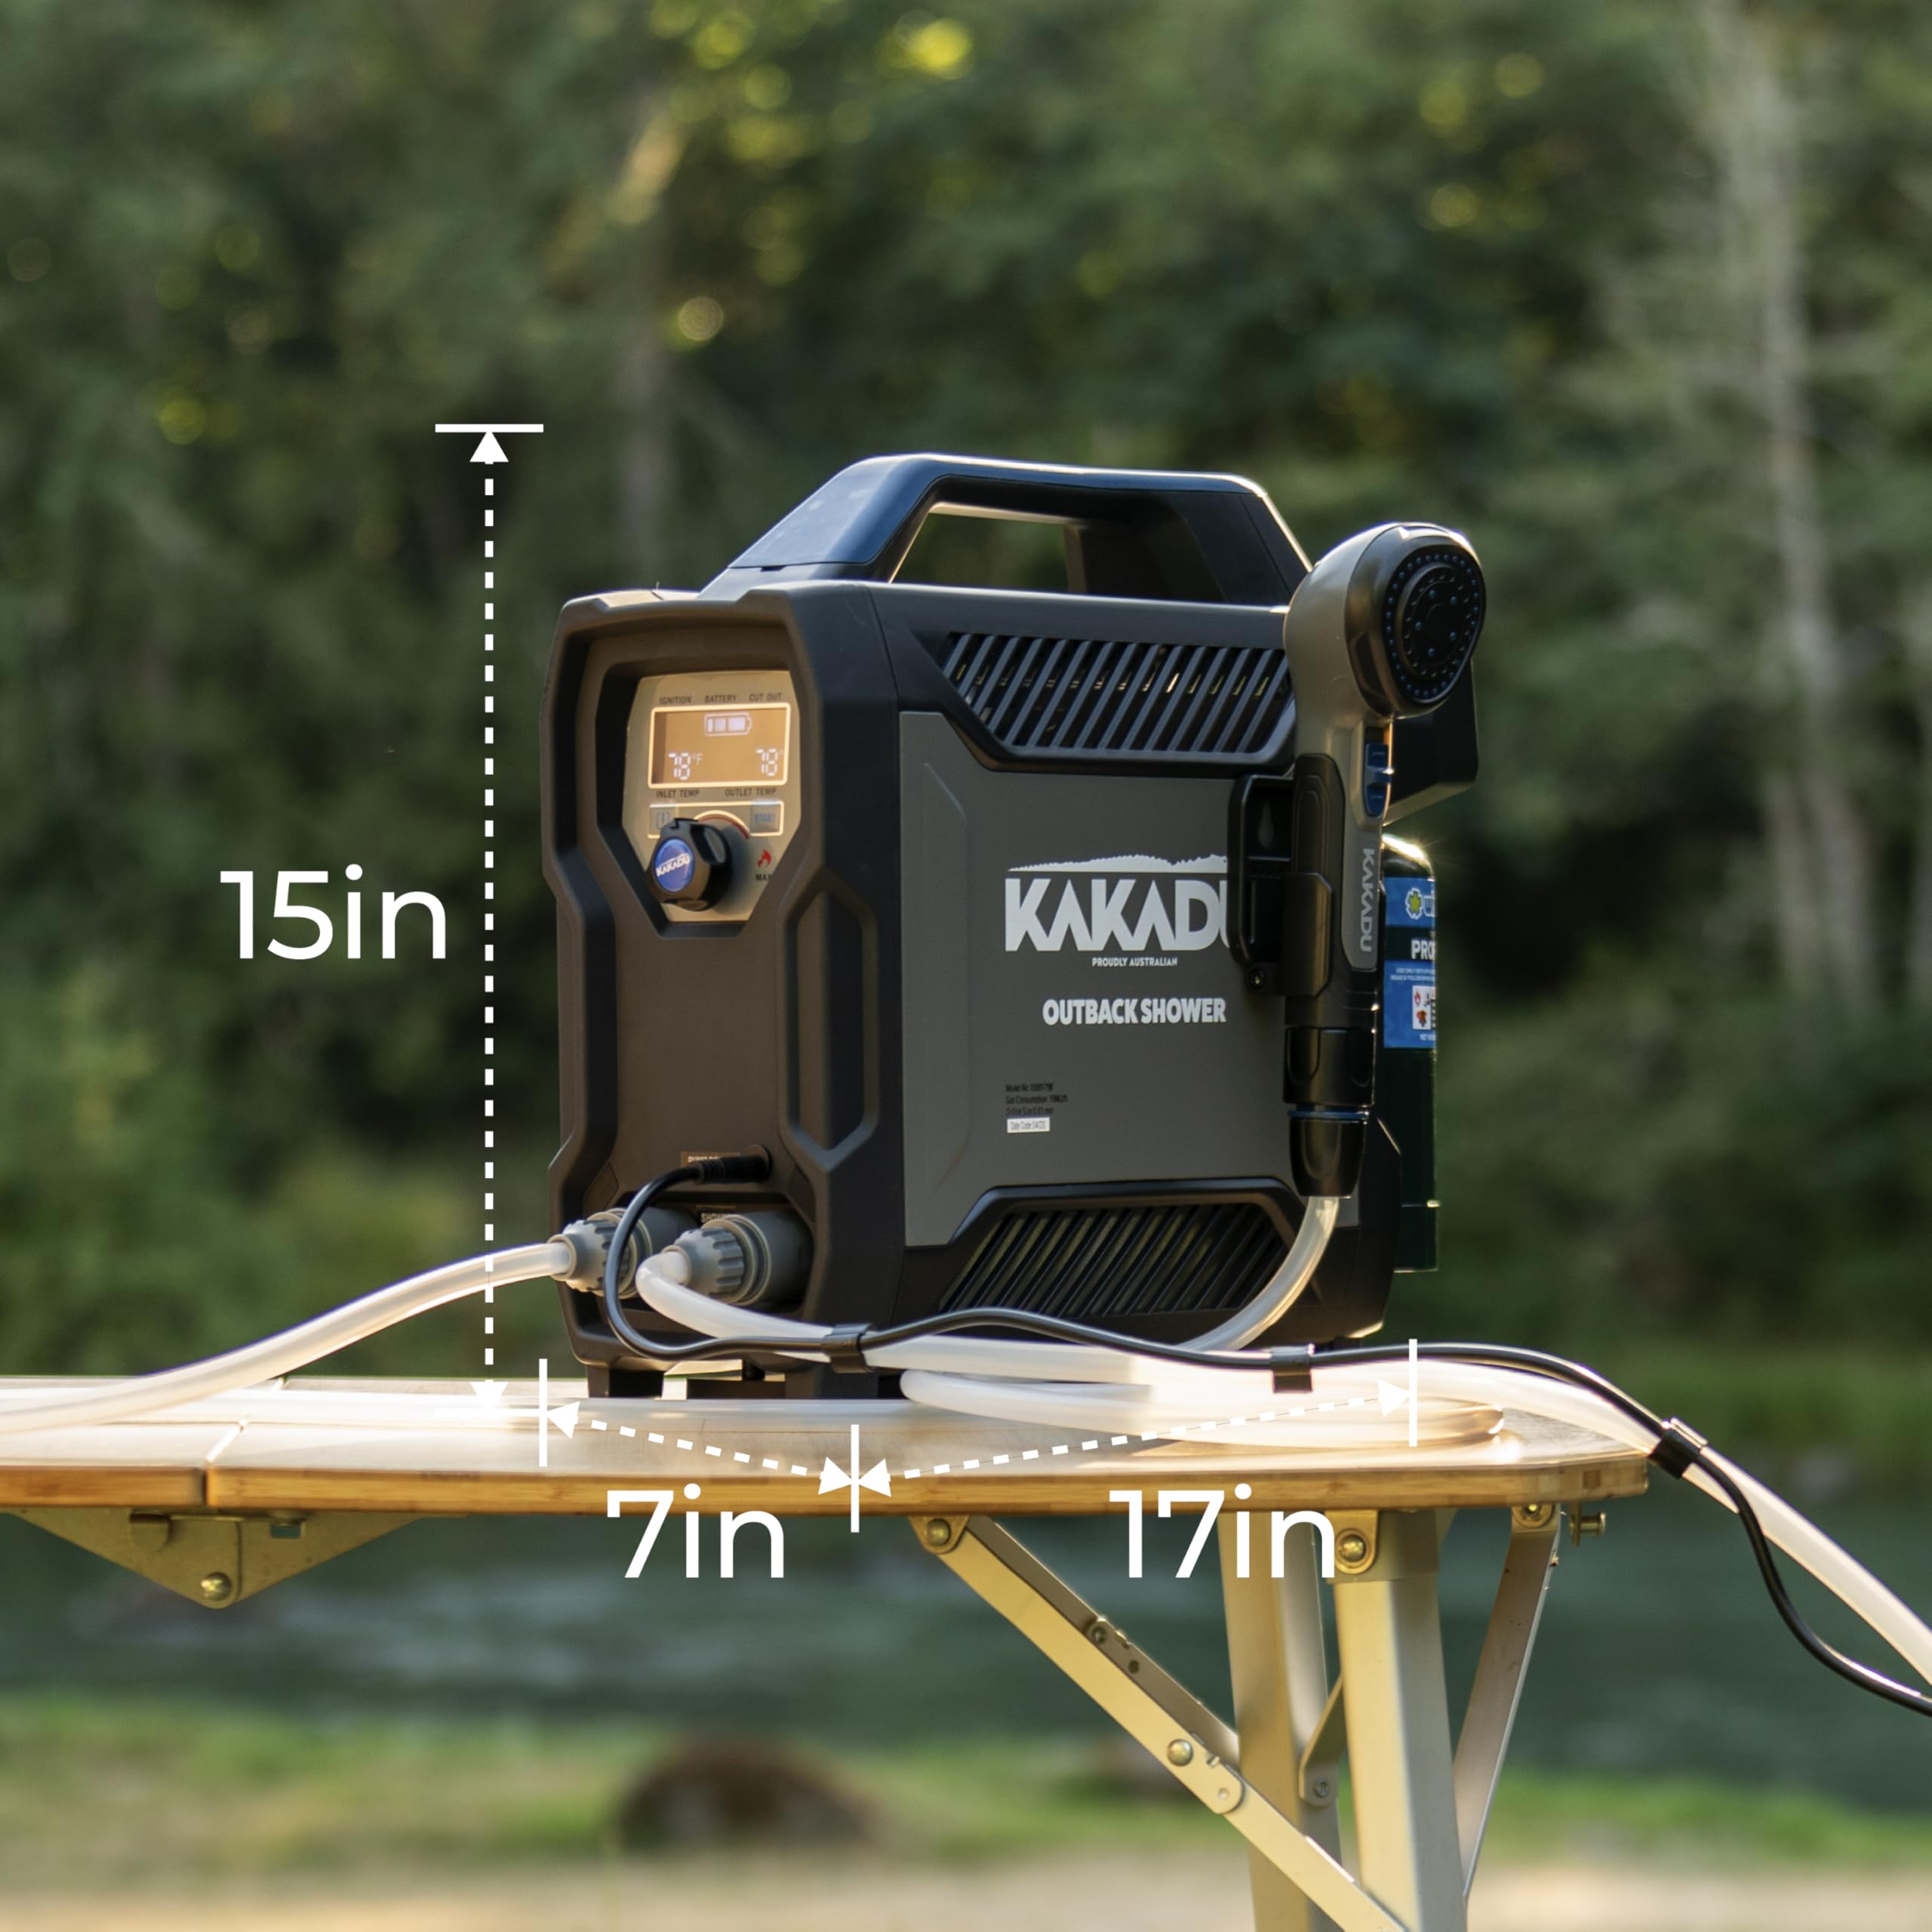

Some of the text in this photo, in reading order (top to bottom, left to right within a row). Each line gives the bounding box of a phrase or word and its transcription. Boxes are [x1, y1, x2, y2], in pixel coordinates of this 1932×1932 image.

[659, 696, 692, 705] IGNITION
[704, 694, 737, 703] BATTERY
[749, 693, 783, 703] CUT OUT
[656, 789, 700, 798] INLET TEMP
[724, 788, 777, 797] OUTLET TEMP
[655, 853, 692, 877] KAKADU
[1360, 848, 1375, 952] KAKADU
[1092, 957, 1177, 967] PROUDLY AUSTRALIAN
[1042, 998, 1226, 1025] OUTBACK SHOWER
